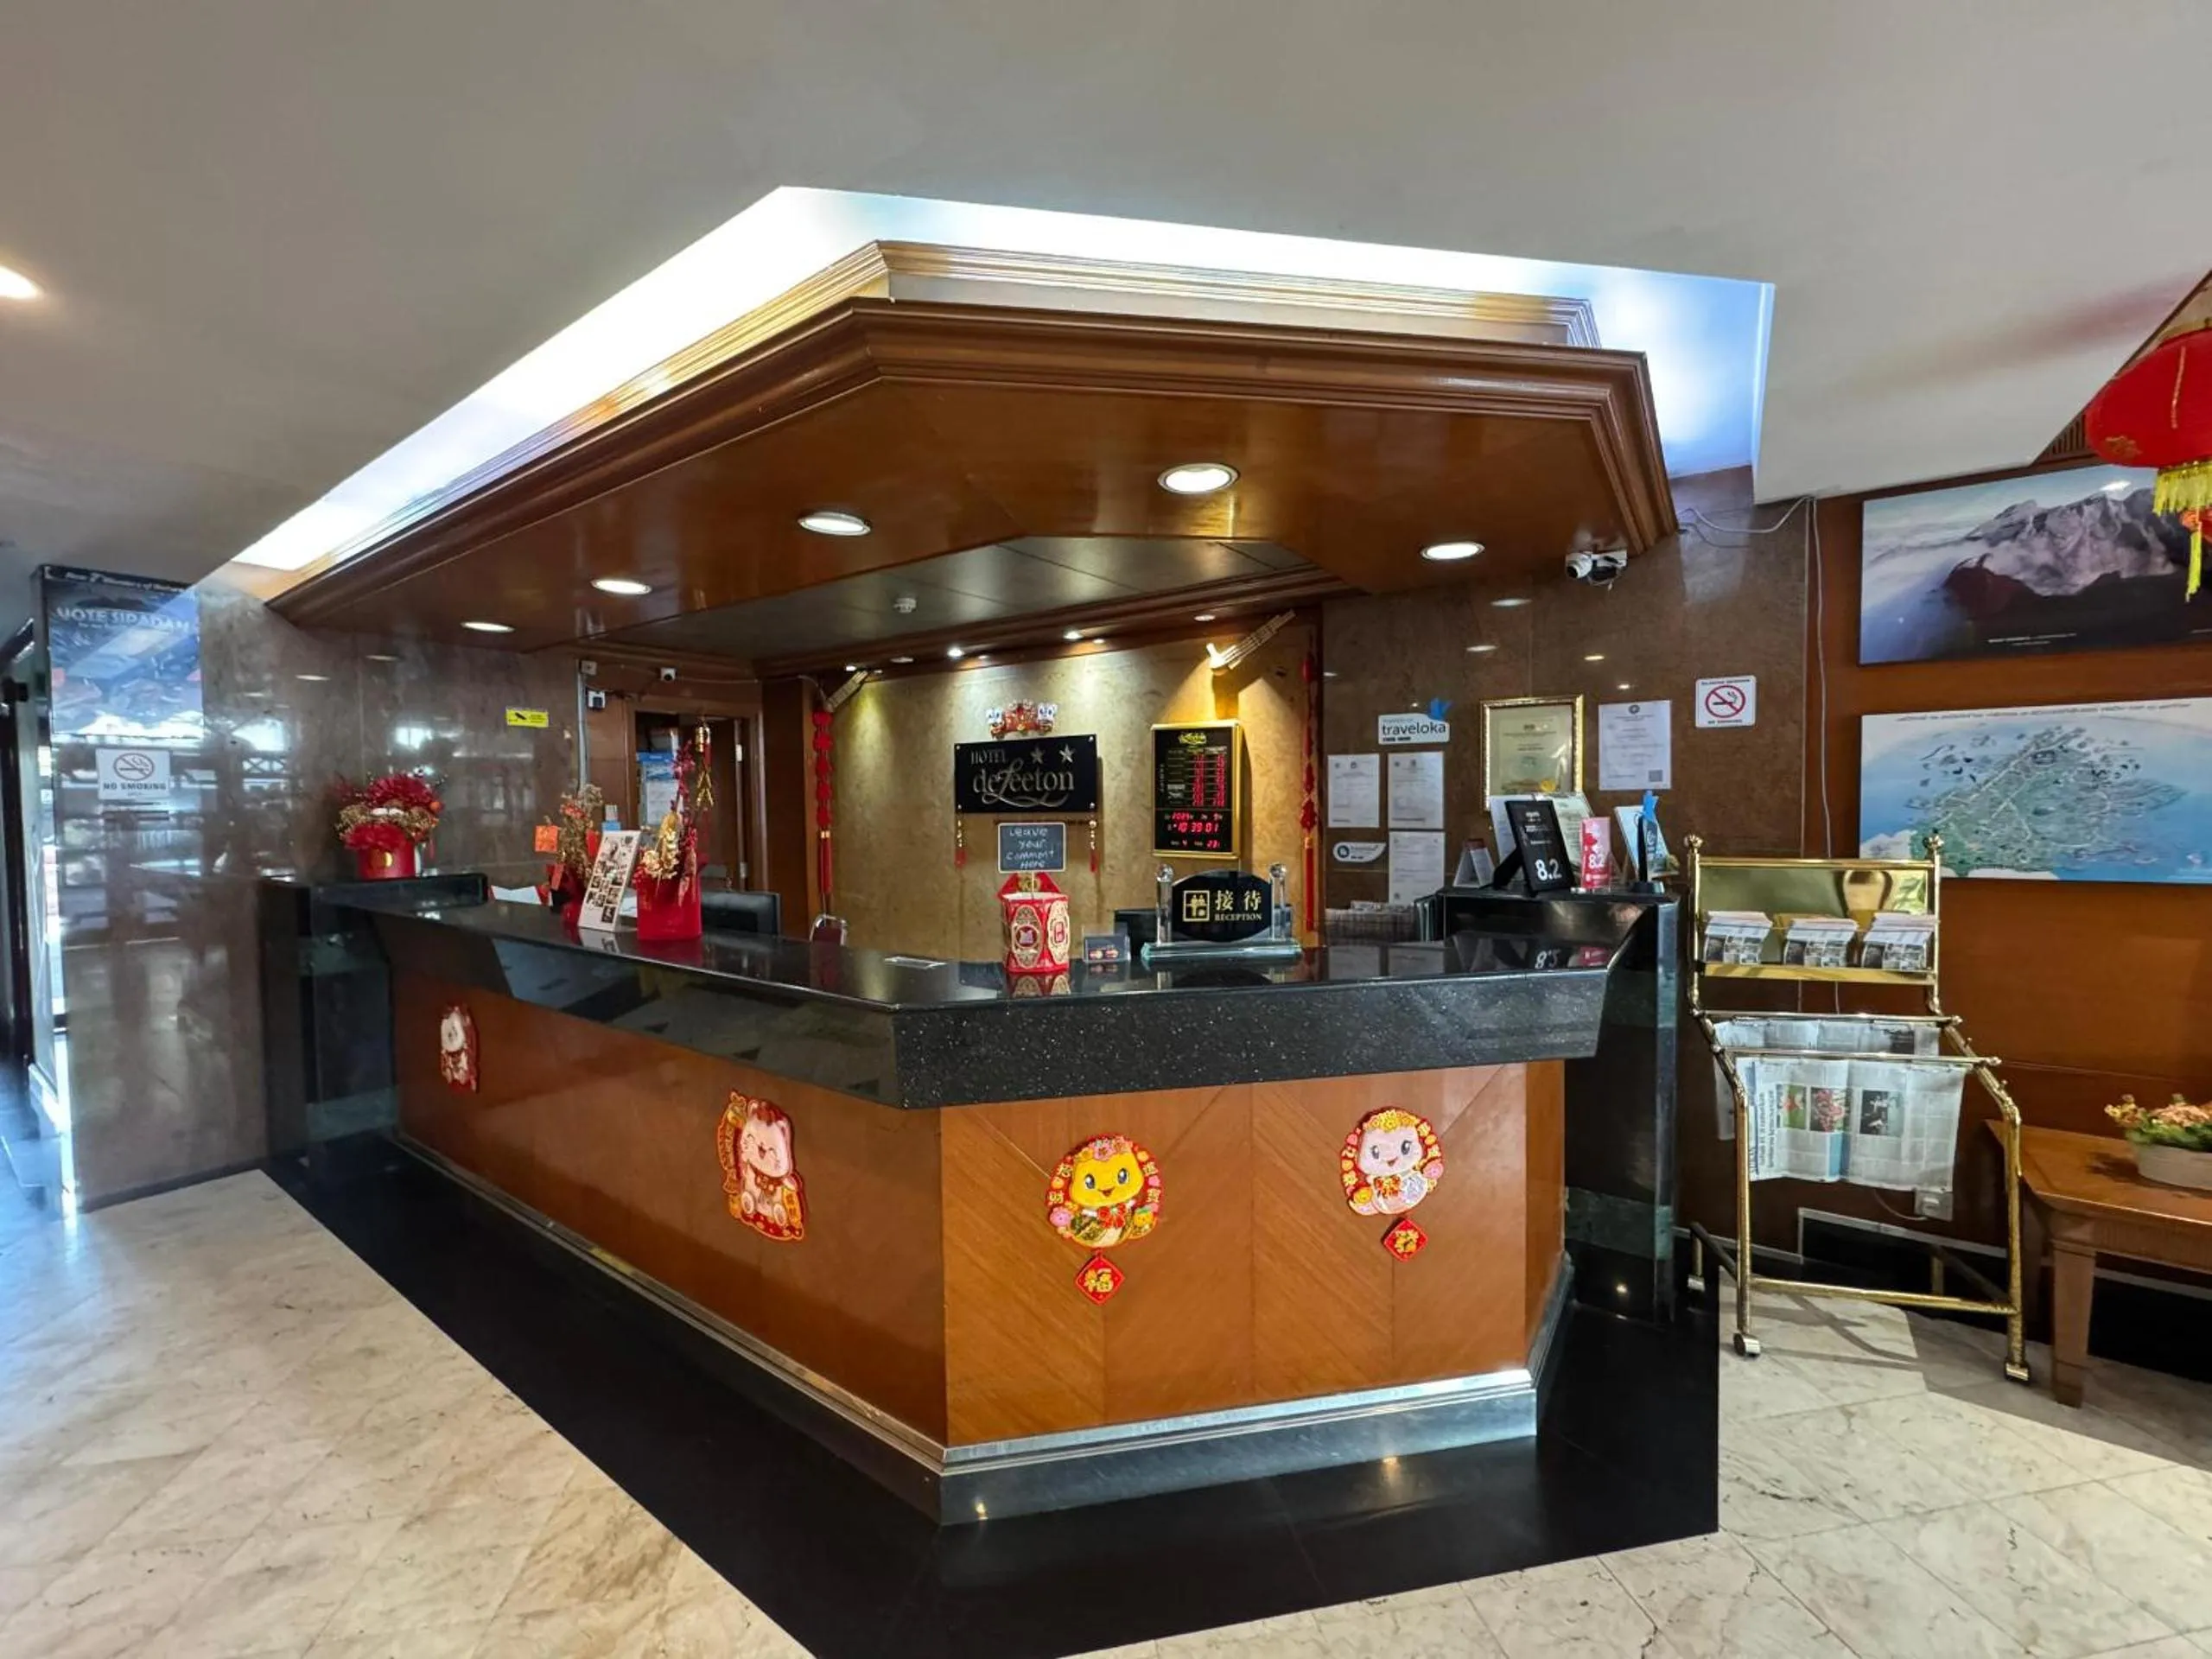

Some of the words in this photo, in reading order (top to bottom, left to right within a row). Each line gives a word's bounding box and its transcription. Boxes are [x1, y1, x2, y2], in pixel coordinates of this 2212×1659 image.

[57, 607, 106, 624] VOTE
[1382, 721, 1446, 735] traveloka
[970, 748, 1007, 765] HOTEL
[1535, 859, 1562, 880] 8.2
[1215, 889, 1262, 911] 接待
